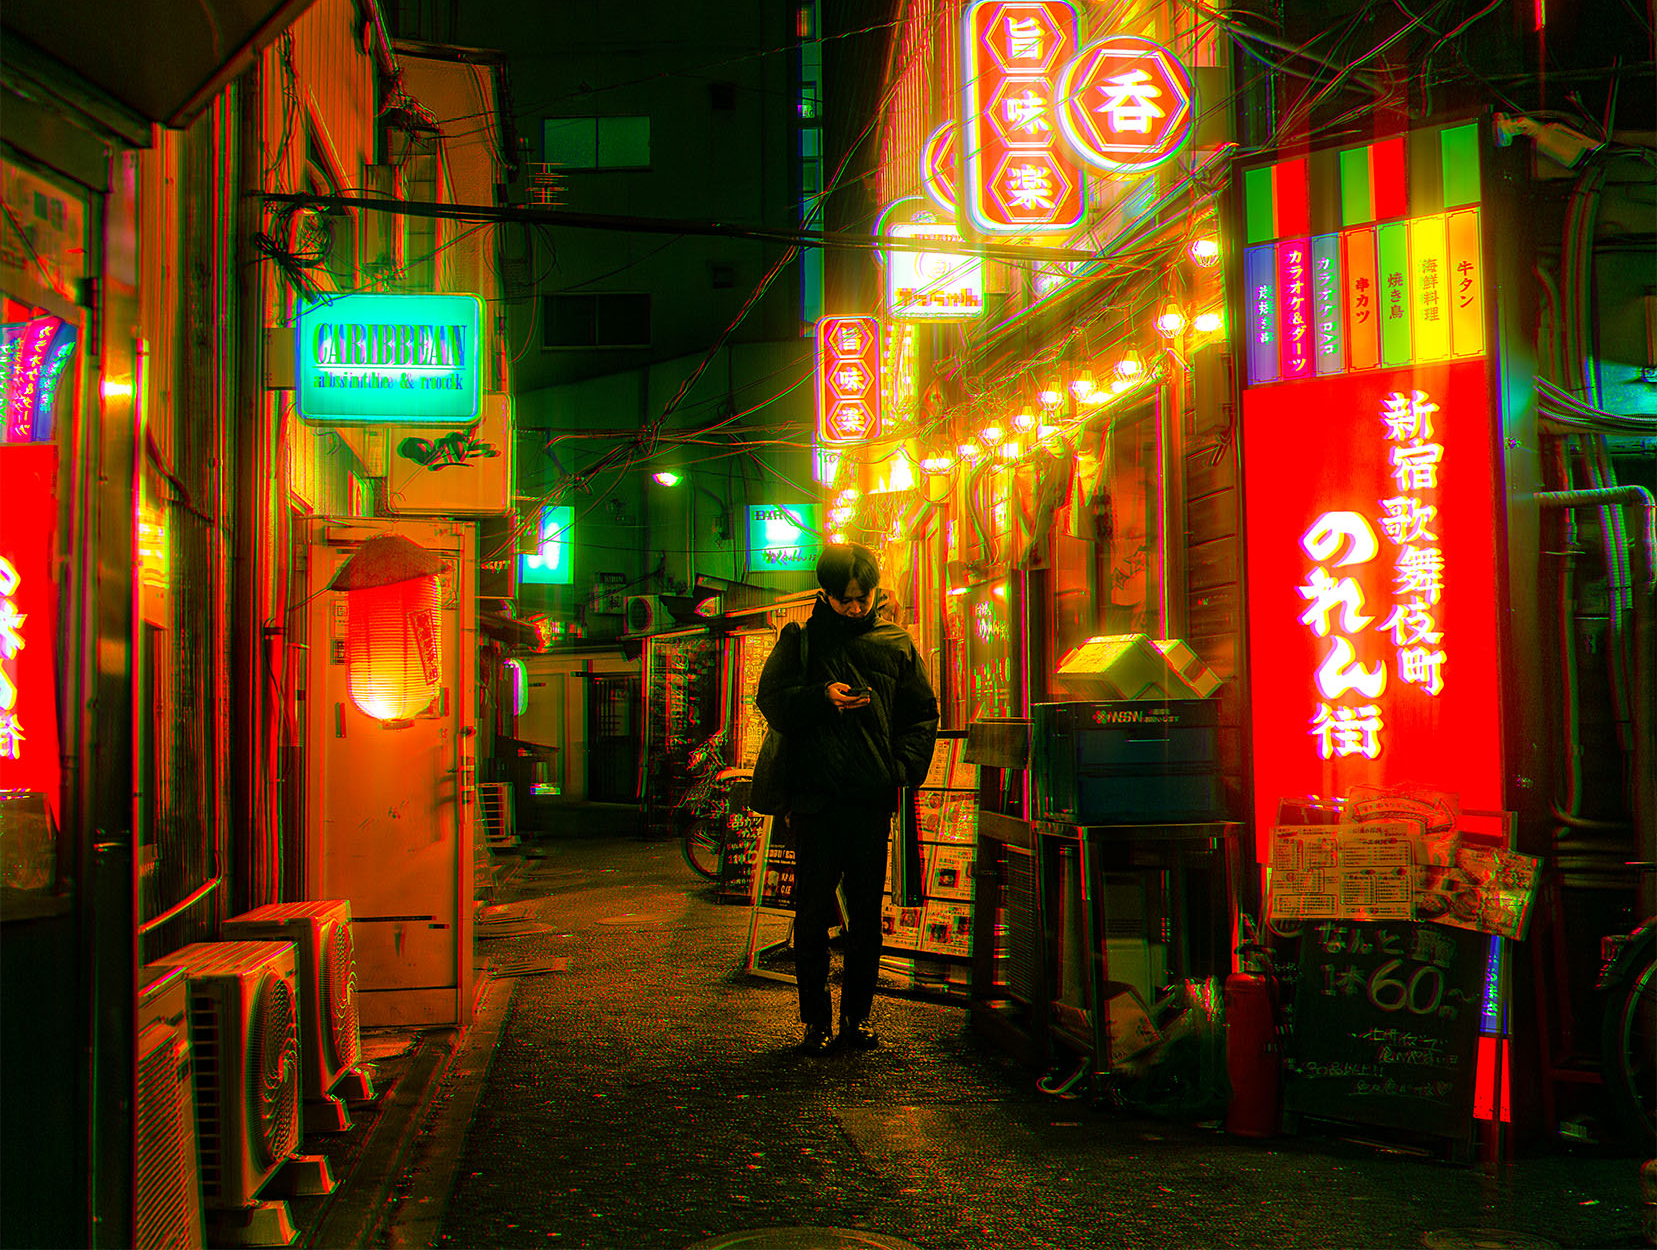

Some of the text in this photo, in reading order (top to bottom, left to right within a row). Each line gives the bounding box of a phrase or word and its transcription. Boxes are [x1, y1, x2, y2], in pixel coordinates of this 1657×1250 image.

[1002, 16, 1057, 210] 旨味楽
[1096, 69, 1165, 134] 呑
[1354, 277, 1371, 324] 串カツ
[1387, 272, 1405, 320] 焼き鳥
[1420, 258, 1440, 322] 海鮮料理
[1457, 260, 1475, 308] 牛タン
[1255, 285, 1275, 345] 炭焼き串
[1286, 250, 1307, 372] カラオケ&ダーツ
[313, 323, 468, 366] CARIBBEAN
[313, 371, 463, 391] absinthe & rock
[753, 509, 787, 521] BAR
[1376, 390, 1447, 697] 新宿歌舞伎町
[1295, 510, 1388, 760] のれん街
[1107, 710, 1143, 723] NSN
[1315, 921, 1404, 955] なんと
